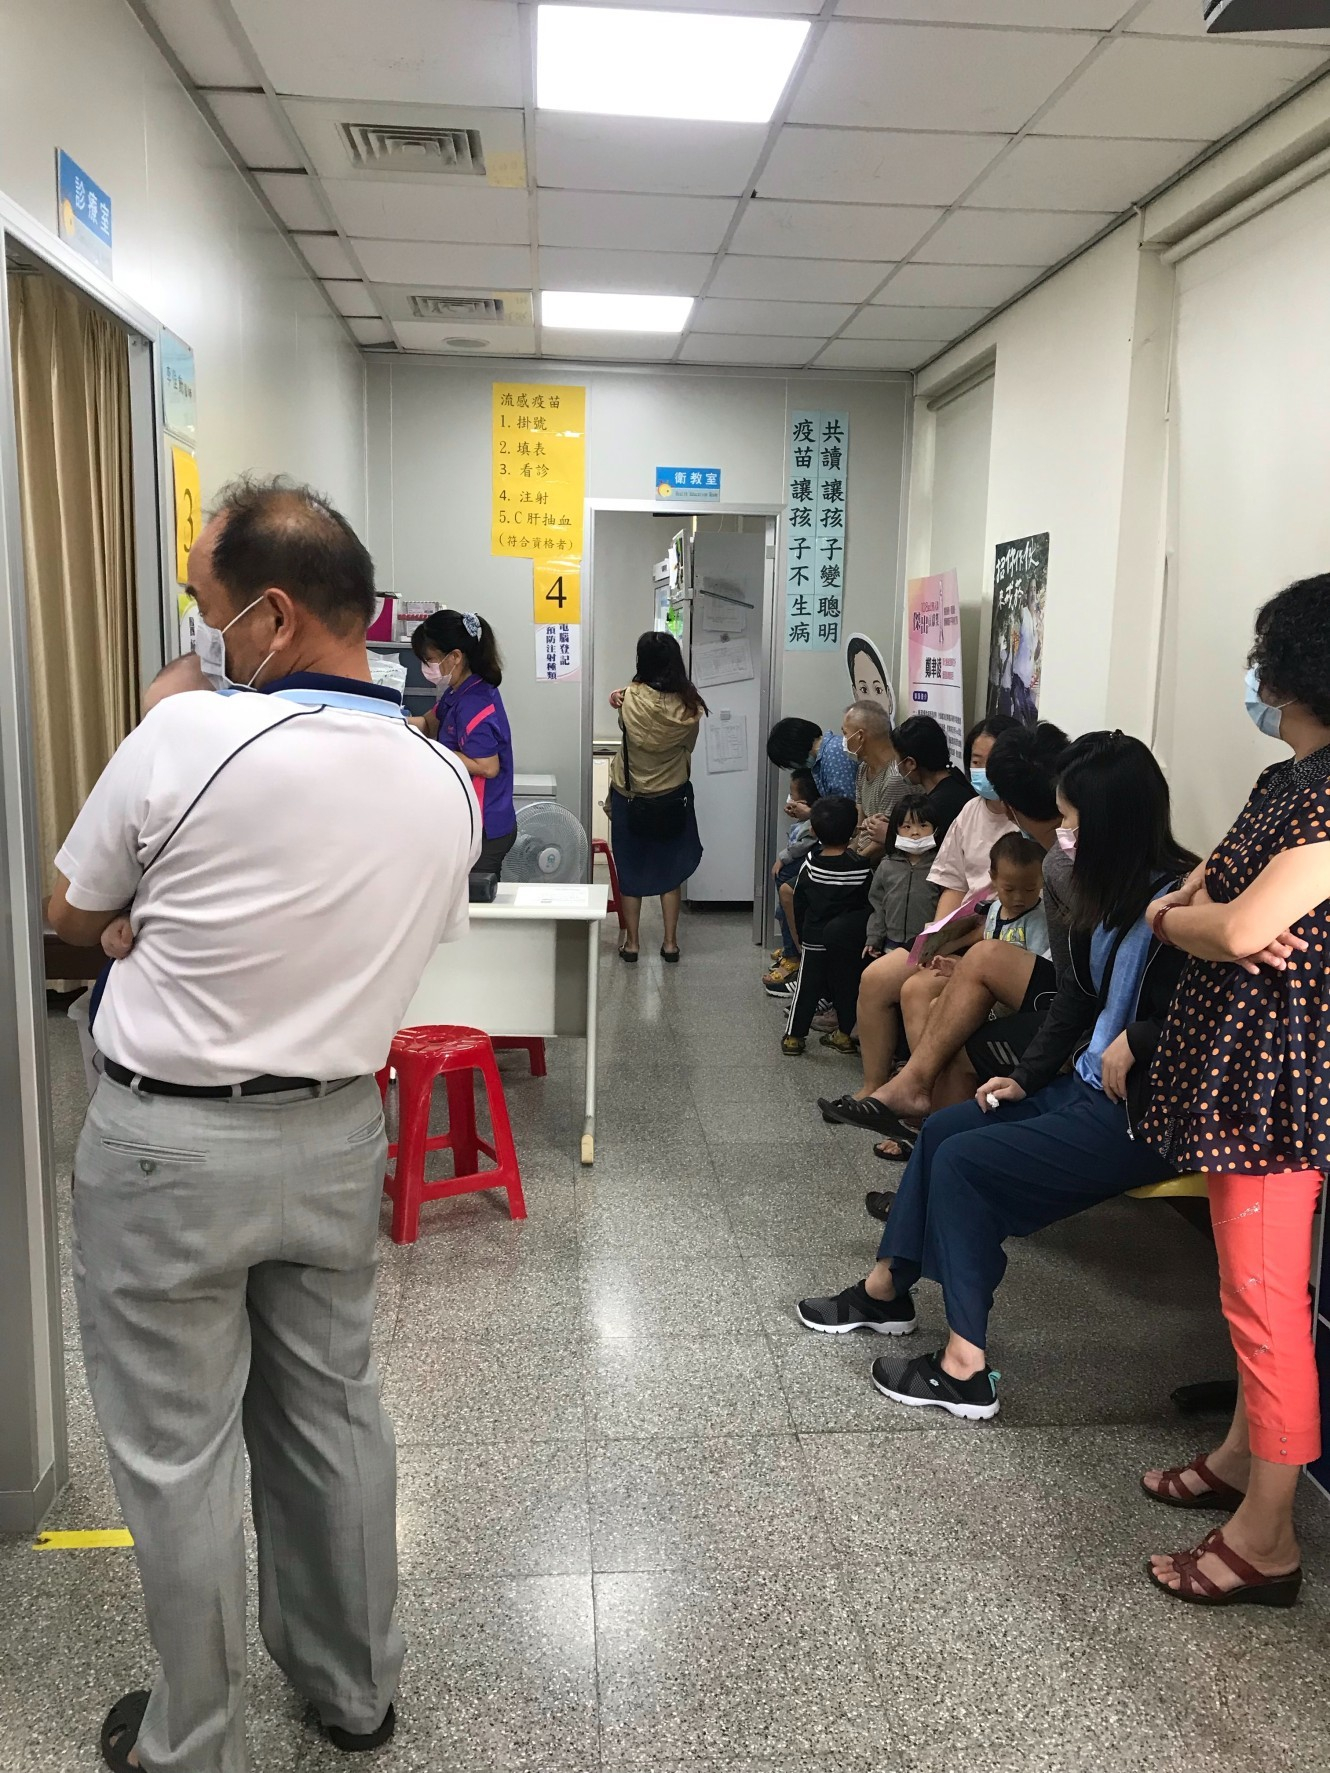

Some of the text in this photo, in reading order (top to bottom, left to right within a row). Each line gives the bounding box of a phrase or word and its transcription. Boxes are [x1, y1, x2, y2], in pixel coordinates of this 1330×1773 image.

[75, 176, 110, 236] 診療室
[500, 393, 560, 409] 流感疫苗
[516, 415, 547, 431] 掛號
[516, 441, 546, 456] 填表
[520, 462, 550, 478] 看診
[675, 471, 718, 486] 衛教室
[520, 490, 549, 504] 注射
[183, 488, 194, 553] 3
[788, 419, 815, 643] 疫苗讓孩子不生病
[817, 419, 845, 643] 共讀讓孩子變聰明
[499, 532, 573, 550] (符合資格者)
[545, 575, 567, 608] 4
[546, 626, 557, 680] 預防注射種類
